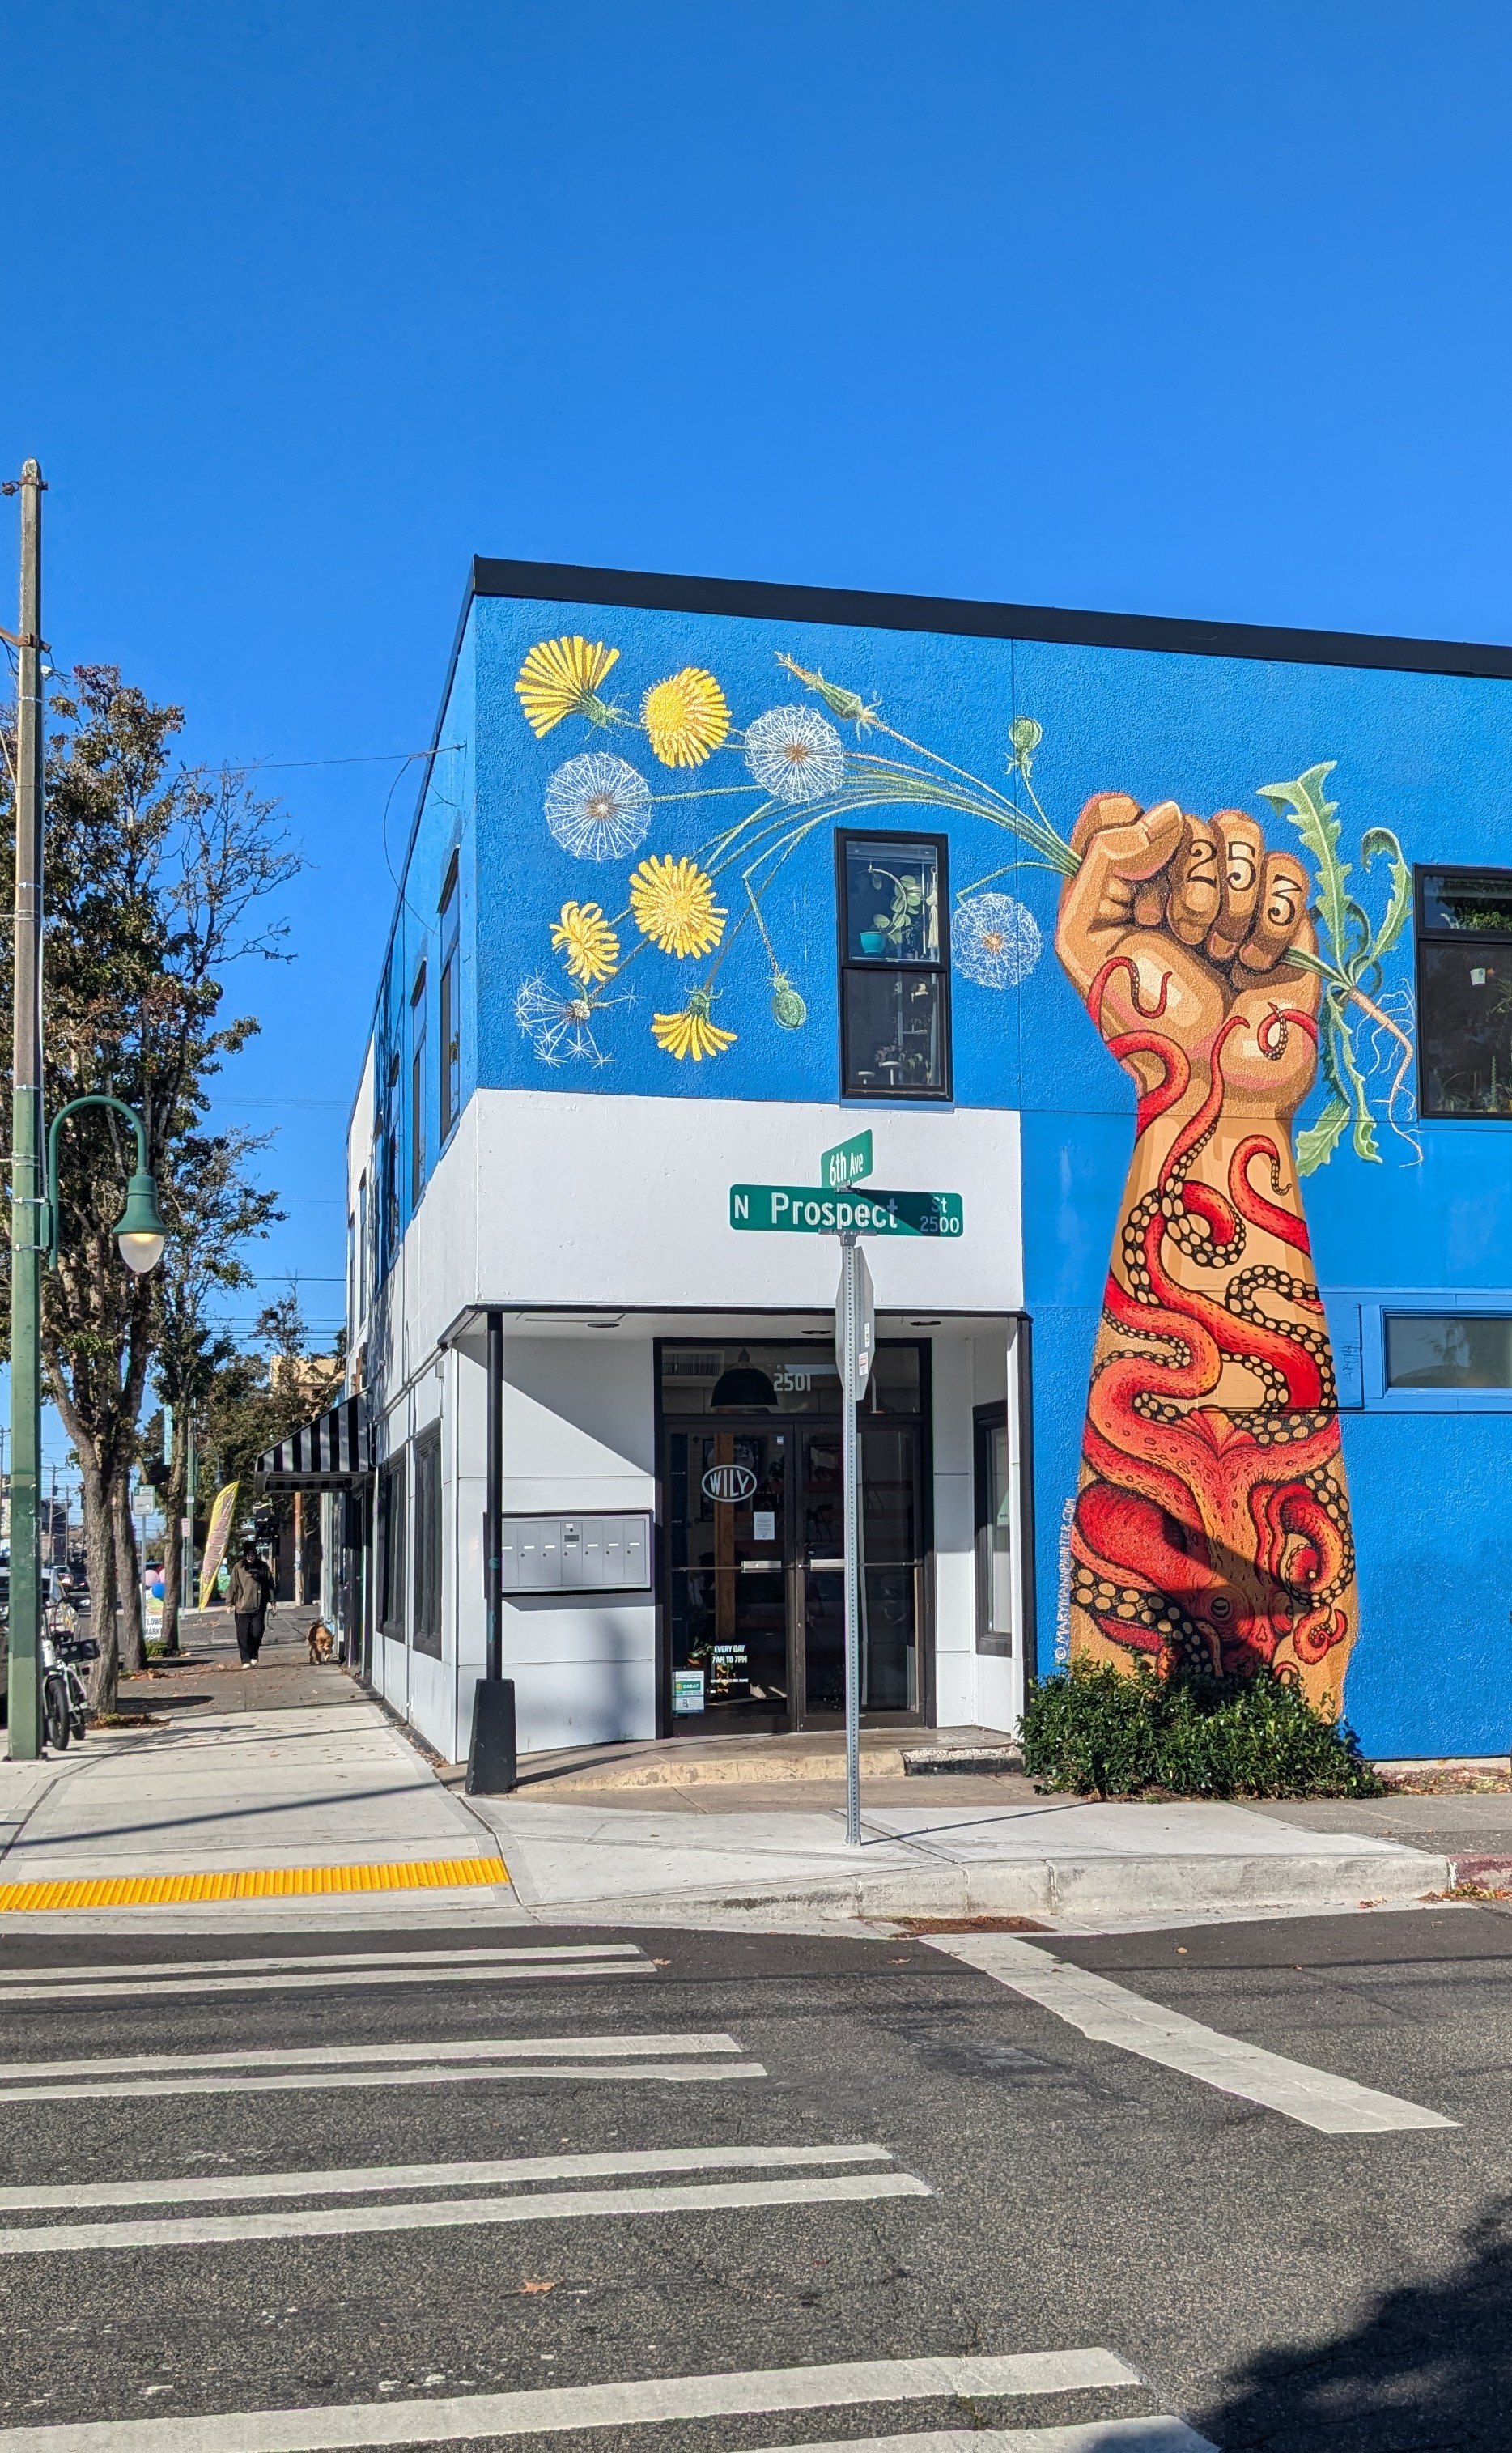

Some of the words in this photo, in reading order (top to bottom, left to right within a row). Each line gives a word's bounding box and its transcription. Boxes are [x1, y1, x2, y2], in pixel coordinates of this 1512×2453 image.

[829, 1151, 847, 1186] 6th
[849, 1152, 864, 1175] Ave
[734, 1194, 749, 1219] N
[771, 1192, 898, 1230] Prospect
[931, 1196, 947, 1214] St
[920, 1215, 959, 1233] 2500
[773, 1372, 811, 1392] 2501
[710, 1469, 750, 1498] WILY
[733, 1644, 745, 1652] DAY
[726, 1656, 734, 1664] TO
[735, 1655, 748, 1664] 7PM
